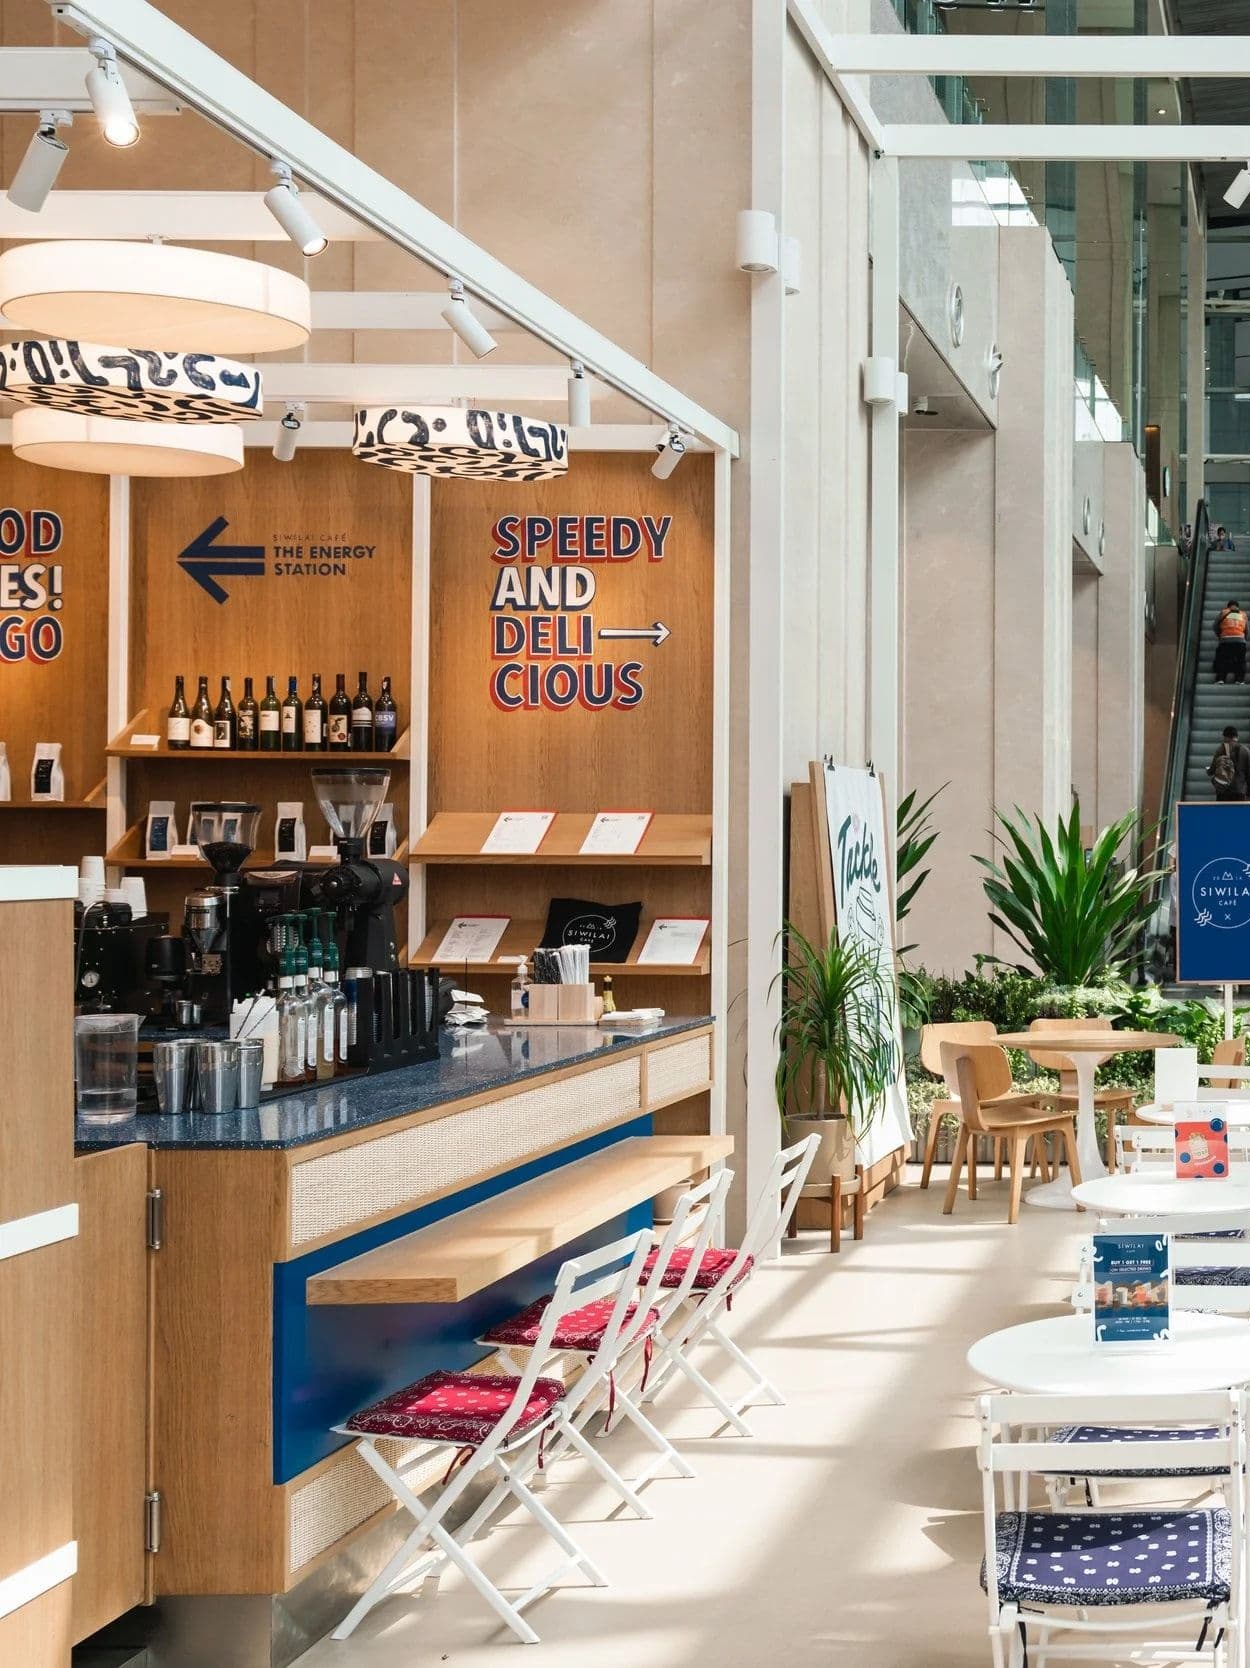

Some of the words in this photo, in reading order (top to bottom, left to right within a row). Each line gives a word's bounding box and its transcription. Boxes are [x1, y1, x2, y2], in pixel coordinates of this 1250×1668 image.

[273, 545, 303, 559] THE
[309, 545, 377, 559] ENERGY
[491, 515, 673, 562] SPEEDY
[0, 563, 63, 612] ES!
[273, 562, 346, 576] STATION
[489, 565, 596, 612] AND
[0, 614, 64, 665] GO
[490, 614, 595, 660] DELI
[489, 661, 645, 712] CIOUS
[567, 929, 610, 940] SIWILAI
